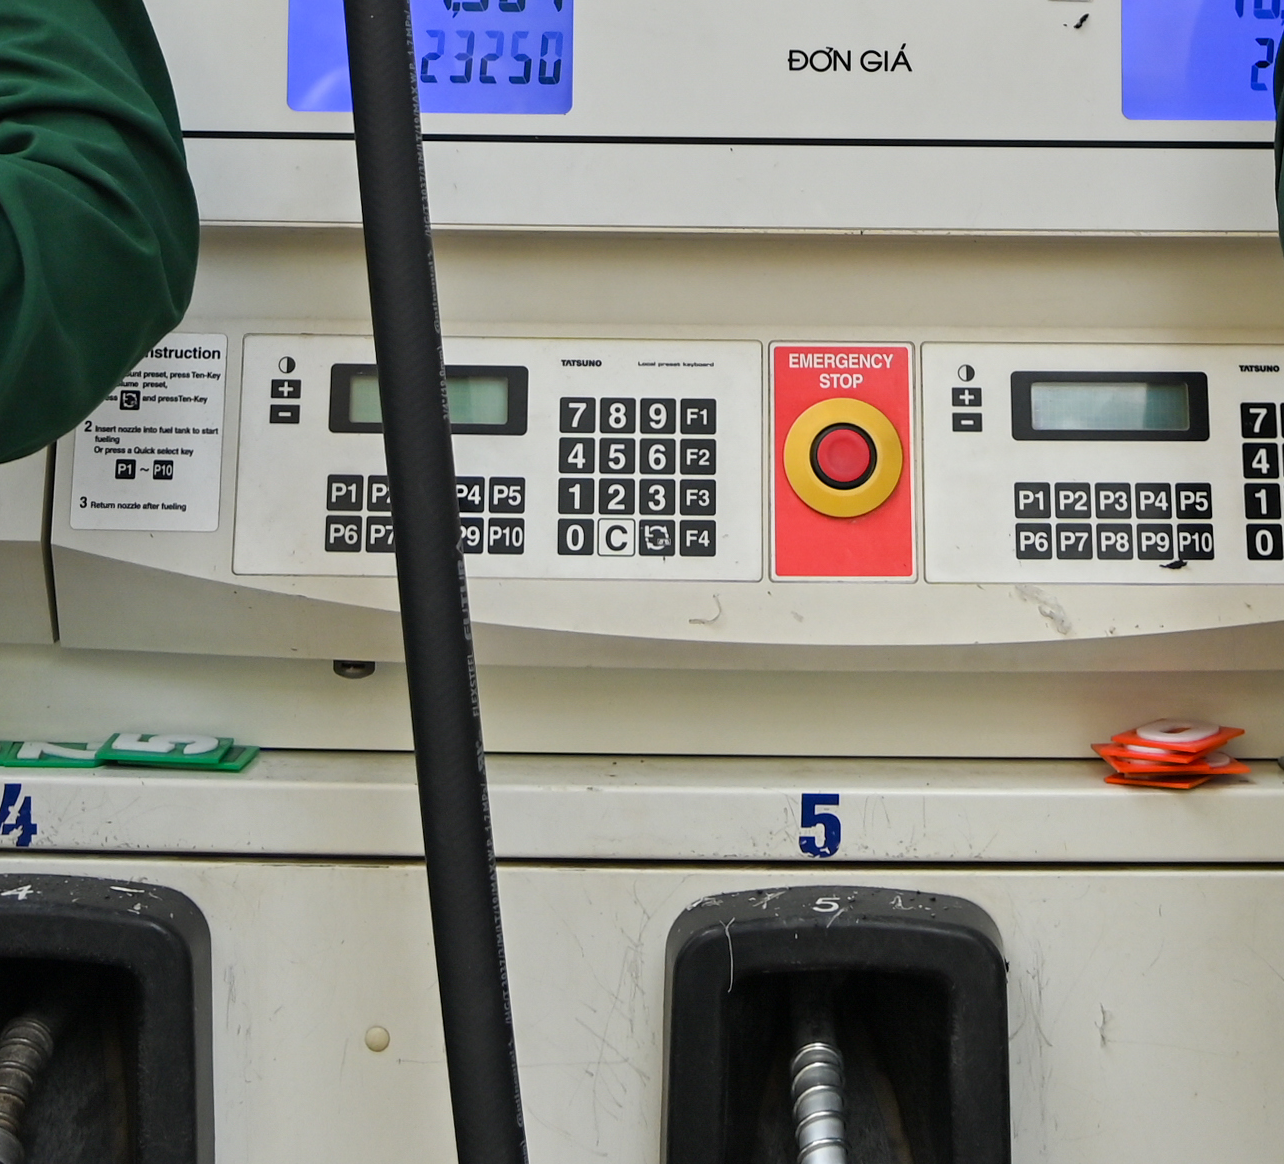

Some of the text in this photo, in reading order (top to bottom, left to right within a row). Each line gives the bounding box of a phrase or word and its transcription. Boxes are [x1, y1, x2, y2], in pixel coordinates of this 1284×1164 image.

[420, 30, 563, 84] 23250
[788, 43, 912, 73] ĐƠN GIÁ
[561, 359, 602, 367] TATSUNO
[788, 352, 894, 370] EMERGENCY
[1238, 365, 1280, 373] TATSUNO
[170, 372, 190, 380] press
[819, 373, 864, 389] STOP
[568, 402, 708, 429] 7 8 9 F1
[1249, 407, 1268, 433] 7
[84, 421, 92, 432] 2
[95, 425, 116, 433] Insert
[159, 426, 173, 434] fuel
[201, 427, 218, 435] start
[95, 435, 120, 444] fueling
[105, 447, 125, 455] press
[133, 446, 155, 454] Quick
[157, 447, 179, 455] select
[181, 448, 194, 457] key
[567, 443, 710, 470] 4 5 6 F2
[1251, 448, 1270, 474] 4
[118, 463, 172, 476] P1 P10
[79, 496, 186, 512] 3 Return nozzle after fueling
[330, 482, 357, 504] P1
[493, 485, 522, 506] P5
[569, 484, 710, 511] 1 2 3 F3
[1019, 490, 1209, 511] P1 P2 P3 P4 P5
[1254, 489, 1268, 515] 1
[329, 524, 358, 545] P6
[489, 526, 523, 548] P10
[566, 525, 710, 551] 0 C F4
[1019, 531, 1213, 553] P6 P7 P8 P9 P10
[1255, 529, 1274, 556] 0
[799, 793, 841, 858] 5
[813, 897, 840, 912] 5
